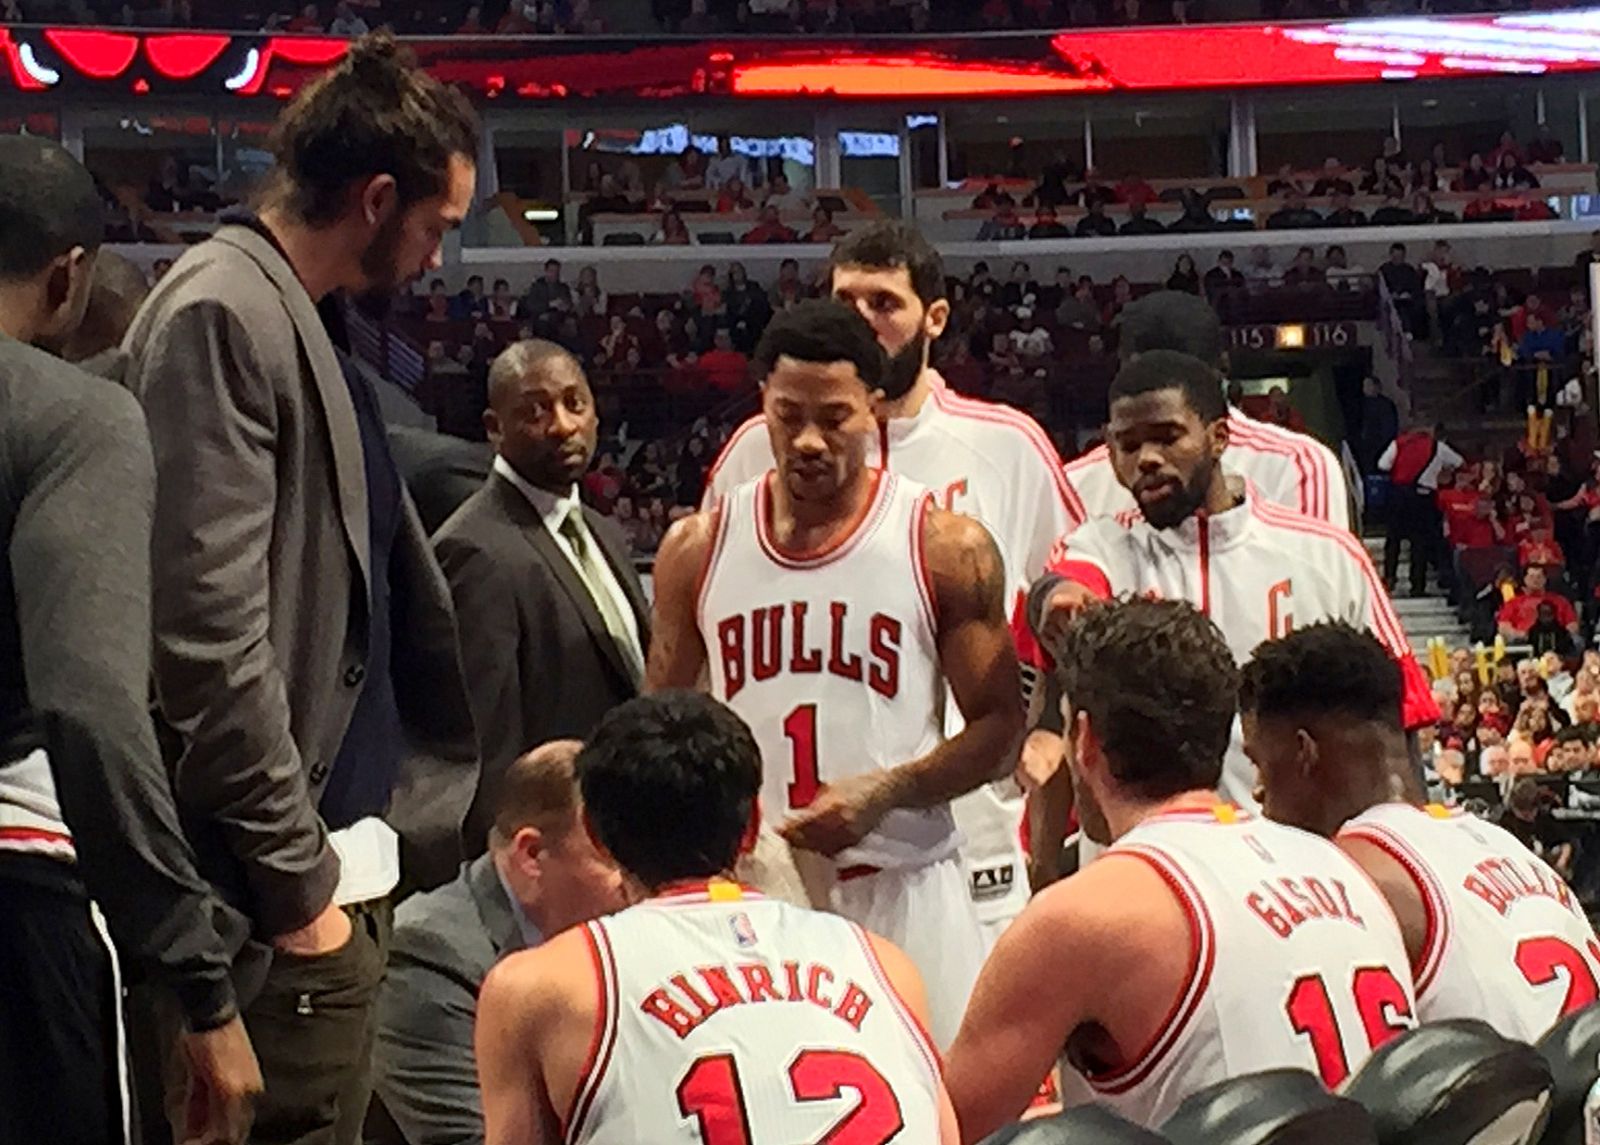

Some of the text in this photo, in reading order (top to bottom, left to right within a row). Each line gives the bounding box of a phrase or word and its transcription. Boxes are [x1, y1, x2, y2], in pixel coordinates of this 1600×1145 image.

[1230, 325, 1348, 348] 115 116
[718, 601, 901, 701] BULLS
[784, 704, 823, 809] 1
[1246, 876, 1366, 938] GASOL
[639, 959, 873, 1039] HINRICH
[1513, 936, 1600, 1021] 2
[1284, 965, 1414, 1094] 16
[675, 1048, 905, 1145] 12
